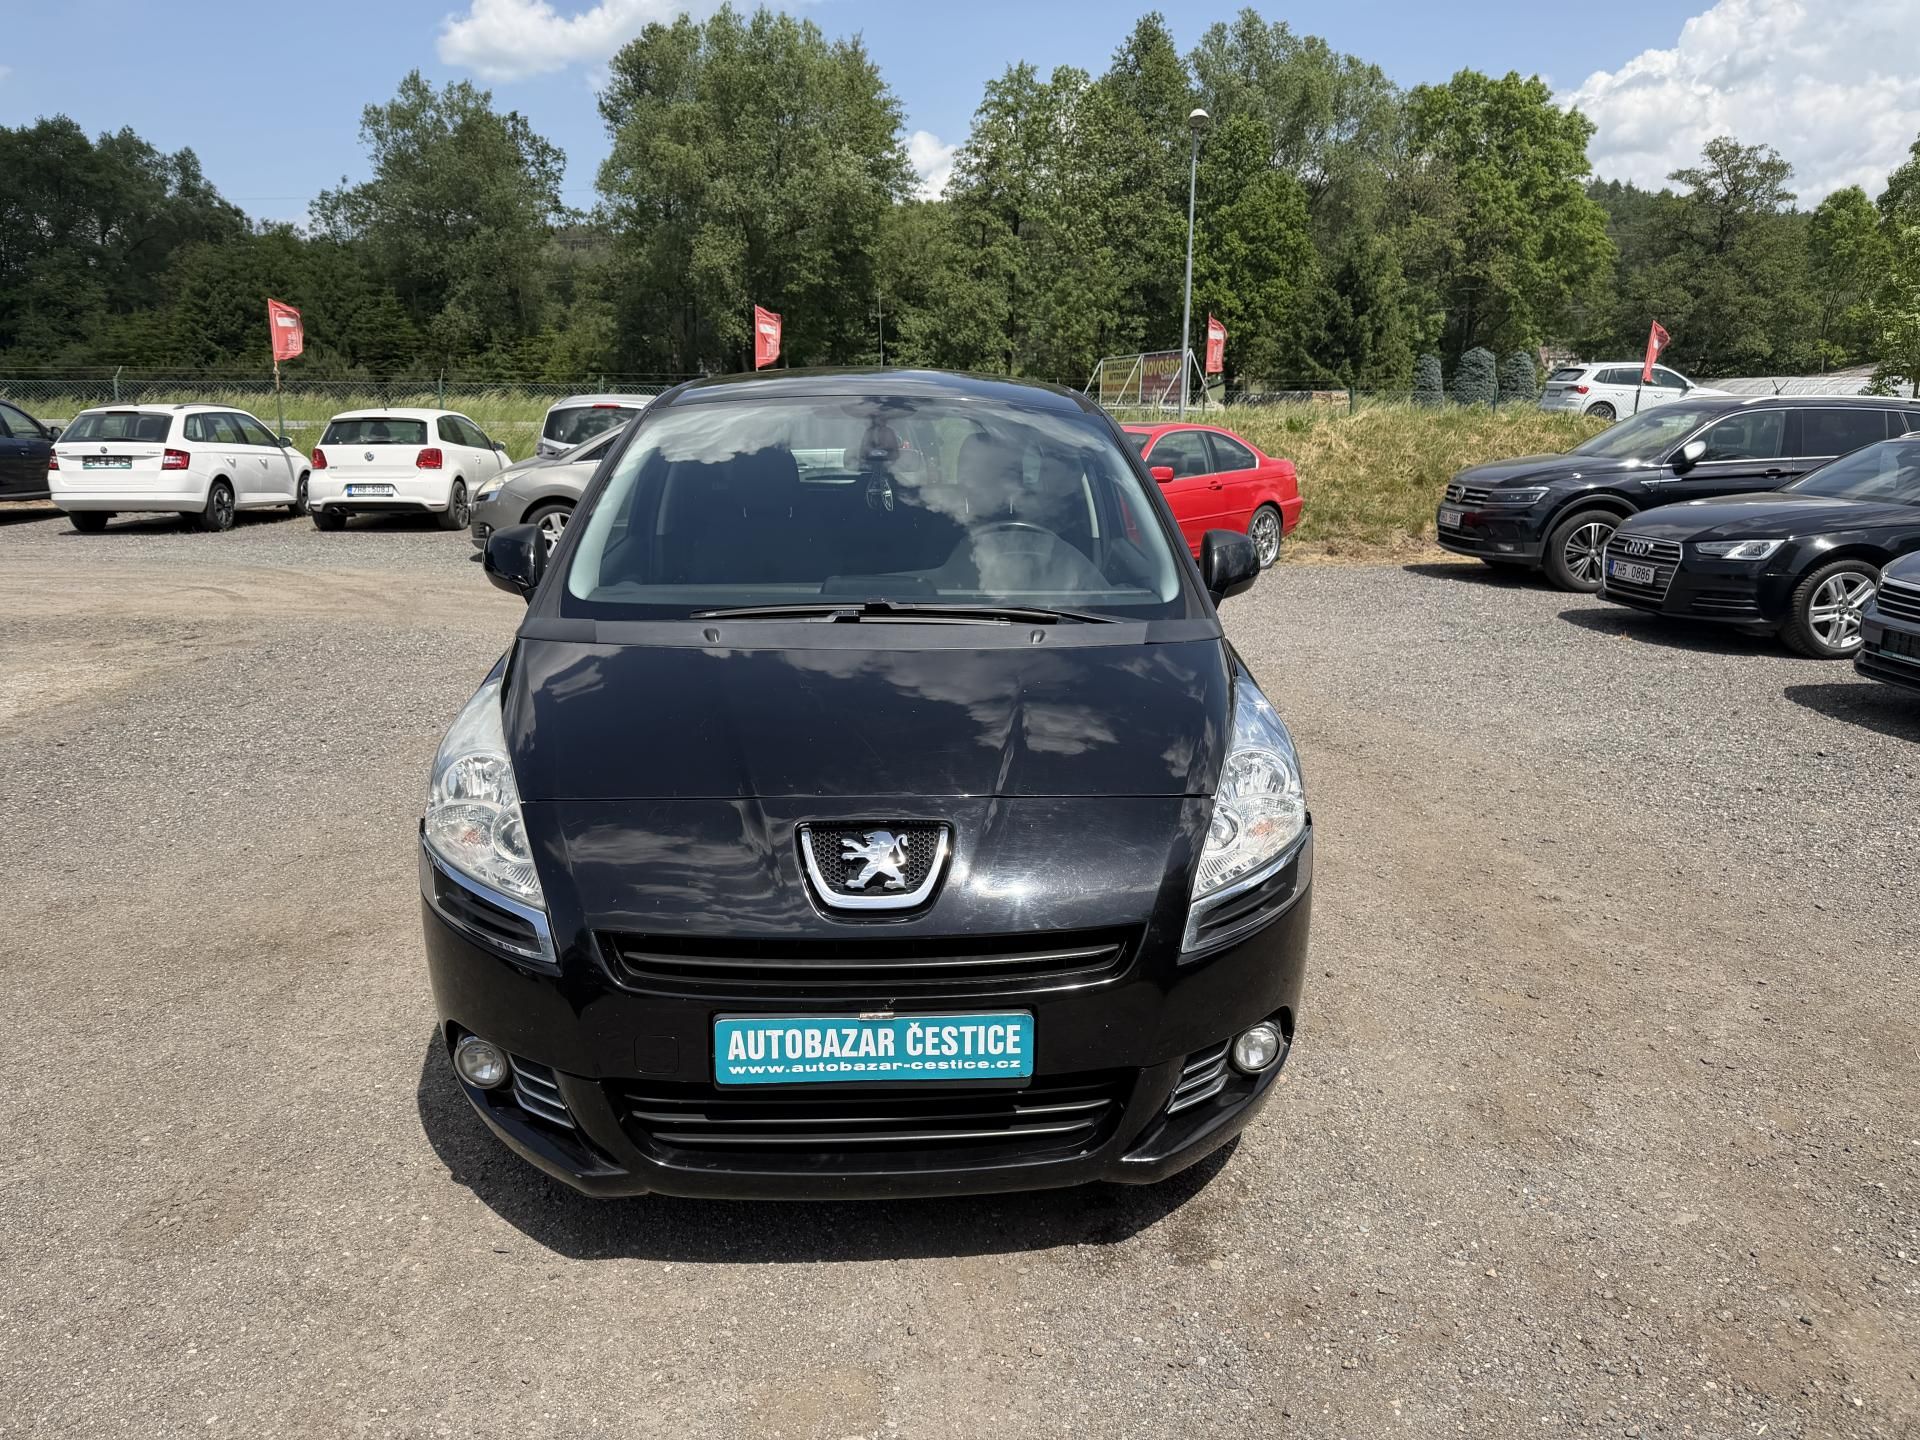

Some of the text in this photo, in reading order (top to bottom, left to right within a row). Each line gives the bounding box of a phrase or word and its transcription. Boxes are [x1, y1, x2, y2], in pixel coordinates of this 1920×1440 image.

[1143, 356, 1182, 376] KOVOŠRO
[1614, 562, 1650, 581] 7H5 0886
[728, 1023, 1021, 1060] AUTOBAZAR ČESTICE
[728, 1060, 1021, 1075] www.autobazar-cestice.cz
